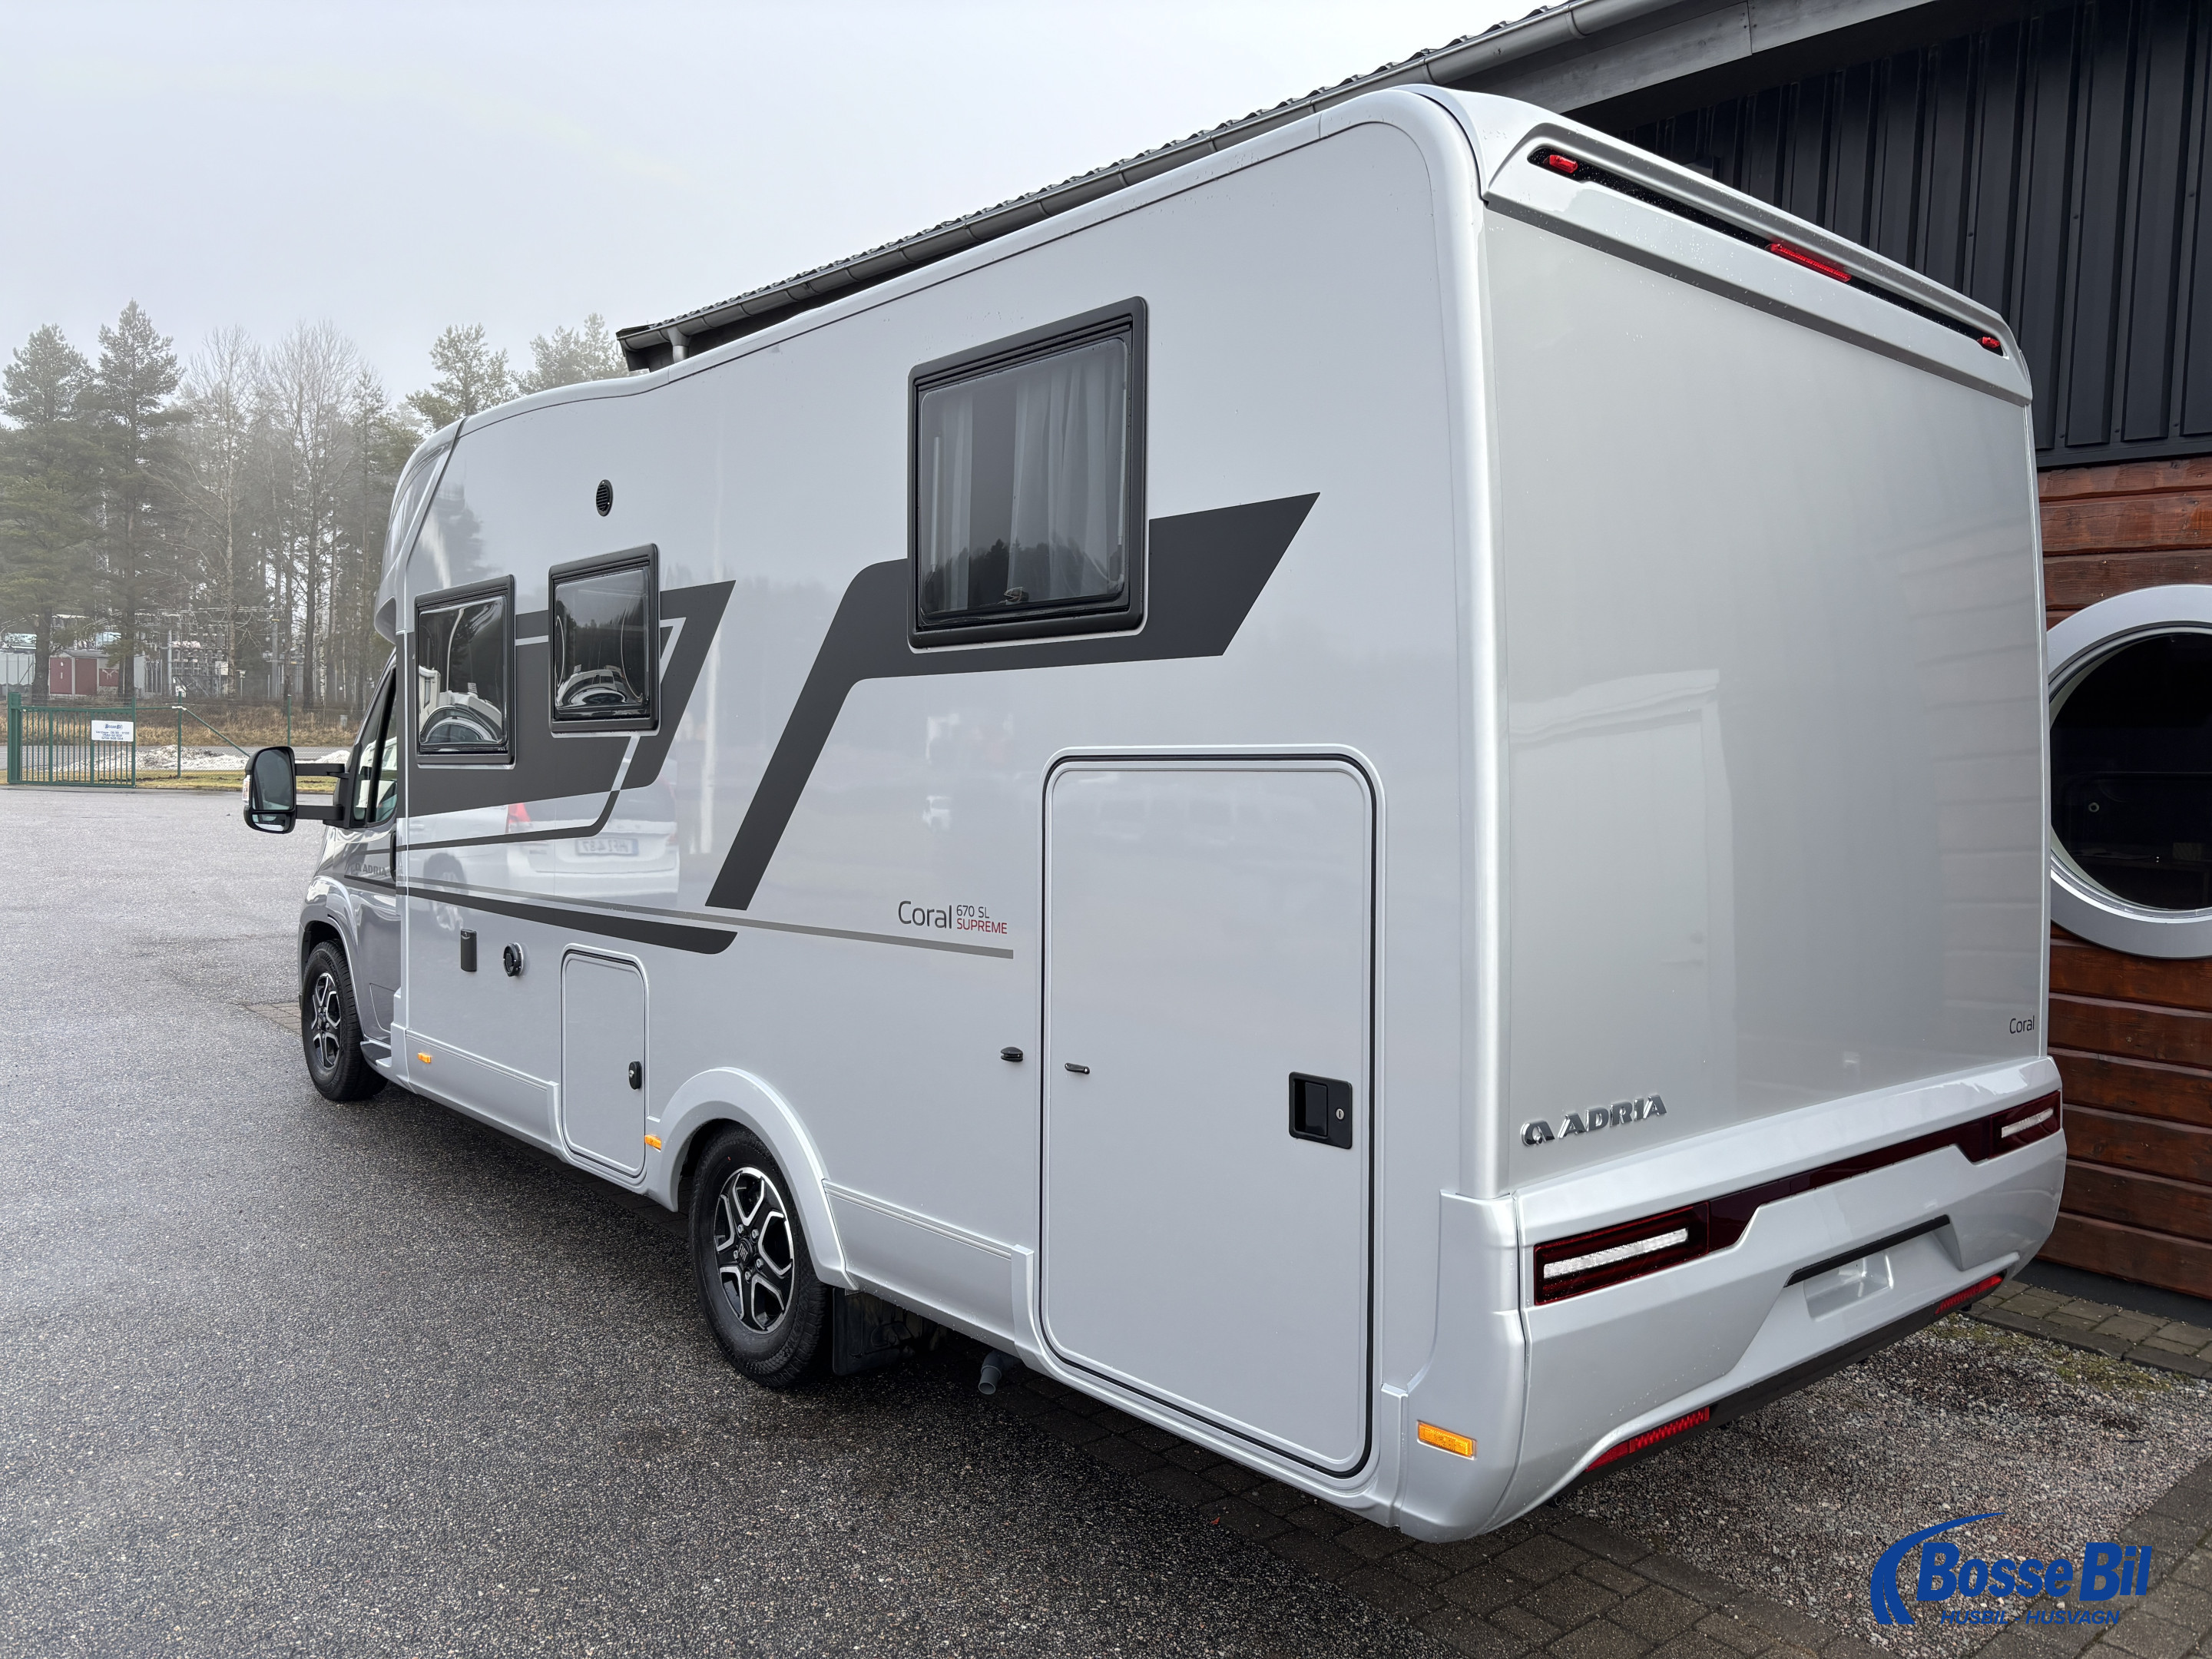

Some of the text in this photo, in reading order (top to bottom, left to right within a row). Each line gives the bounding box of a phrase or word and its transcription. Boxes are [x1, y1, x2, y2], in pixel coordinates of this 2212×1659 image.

[363, 863, 387, 876] ADRIA
[898, 900, 990, 929] Coral 670 SL
[956, 918, 1008, 935] SUPREME
[2009, 1015, 2035, 1035] Coral
[1557, 1094, 1667, 1139] ADRIA
[738, 1242, 749, 1262] FIAT
